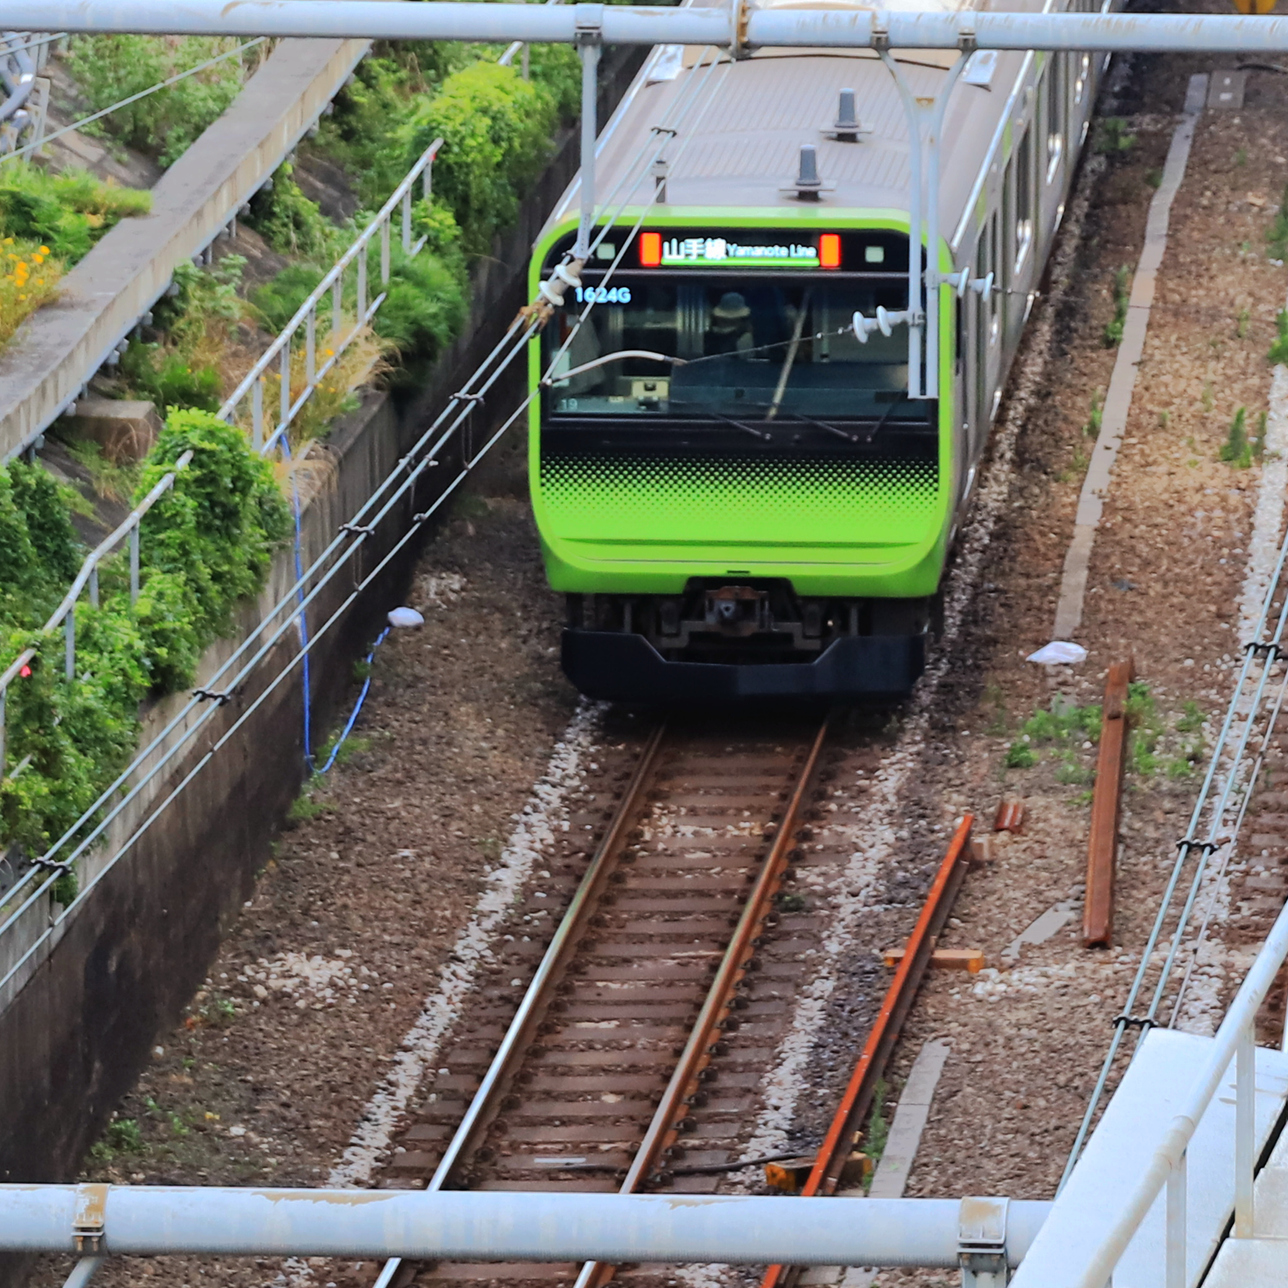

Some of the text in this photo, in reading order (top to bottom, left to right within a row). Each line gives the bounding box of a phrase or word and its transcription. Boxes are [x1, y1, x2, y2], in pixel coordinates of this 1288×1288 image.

[663, 238, 816, 260] 山手線 Yamanote Line
[575, 287, 631, 304] 1624G
[562, 399, 578, 410] 19
